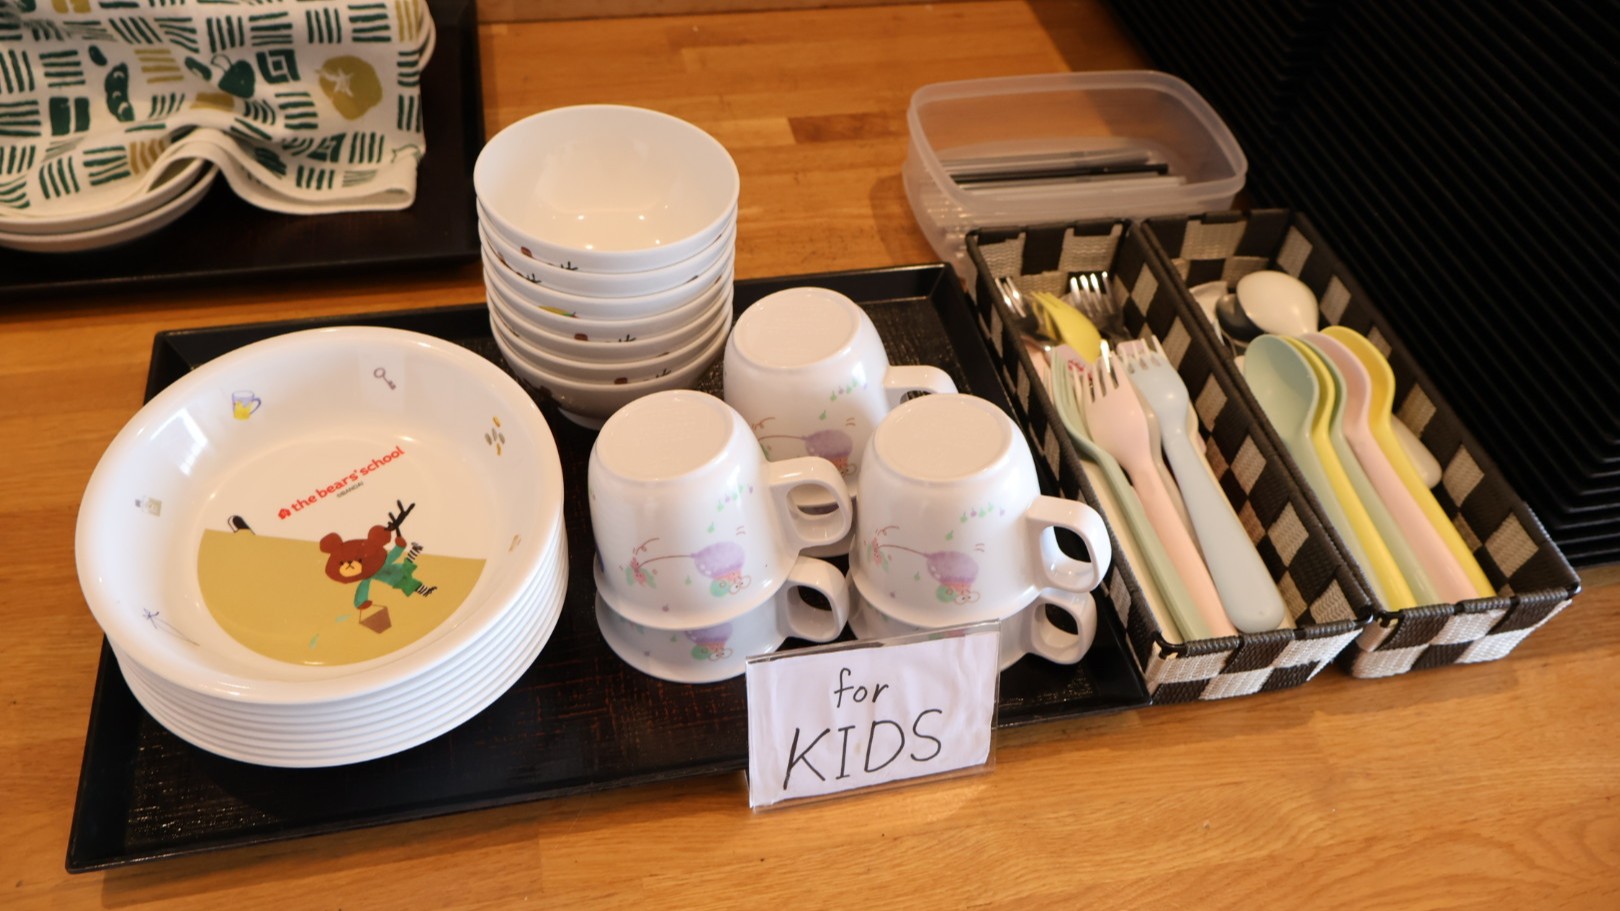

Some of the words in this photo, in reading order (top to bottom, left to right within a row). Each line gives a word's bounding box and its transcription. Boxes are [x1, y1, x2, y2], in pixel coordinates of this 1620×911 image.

[291, 495, 317, 512] the
[359, 445, 405, 476] school
[833, 667, 889, 708] for
[783, 708, 943, 790] KIDS
